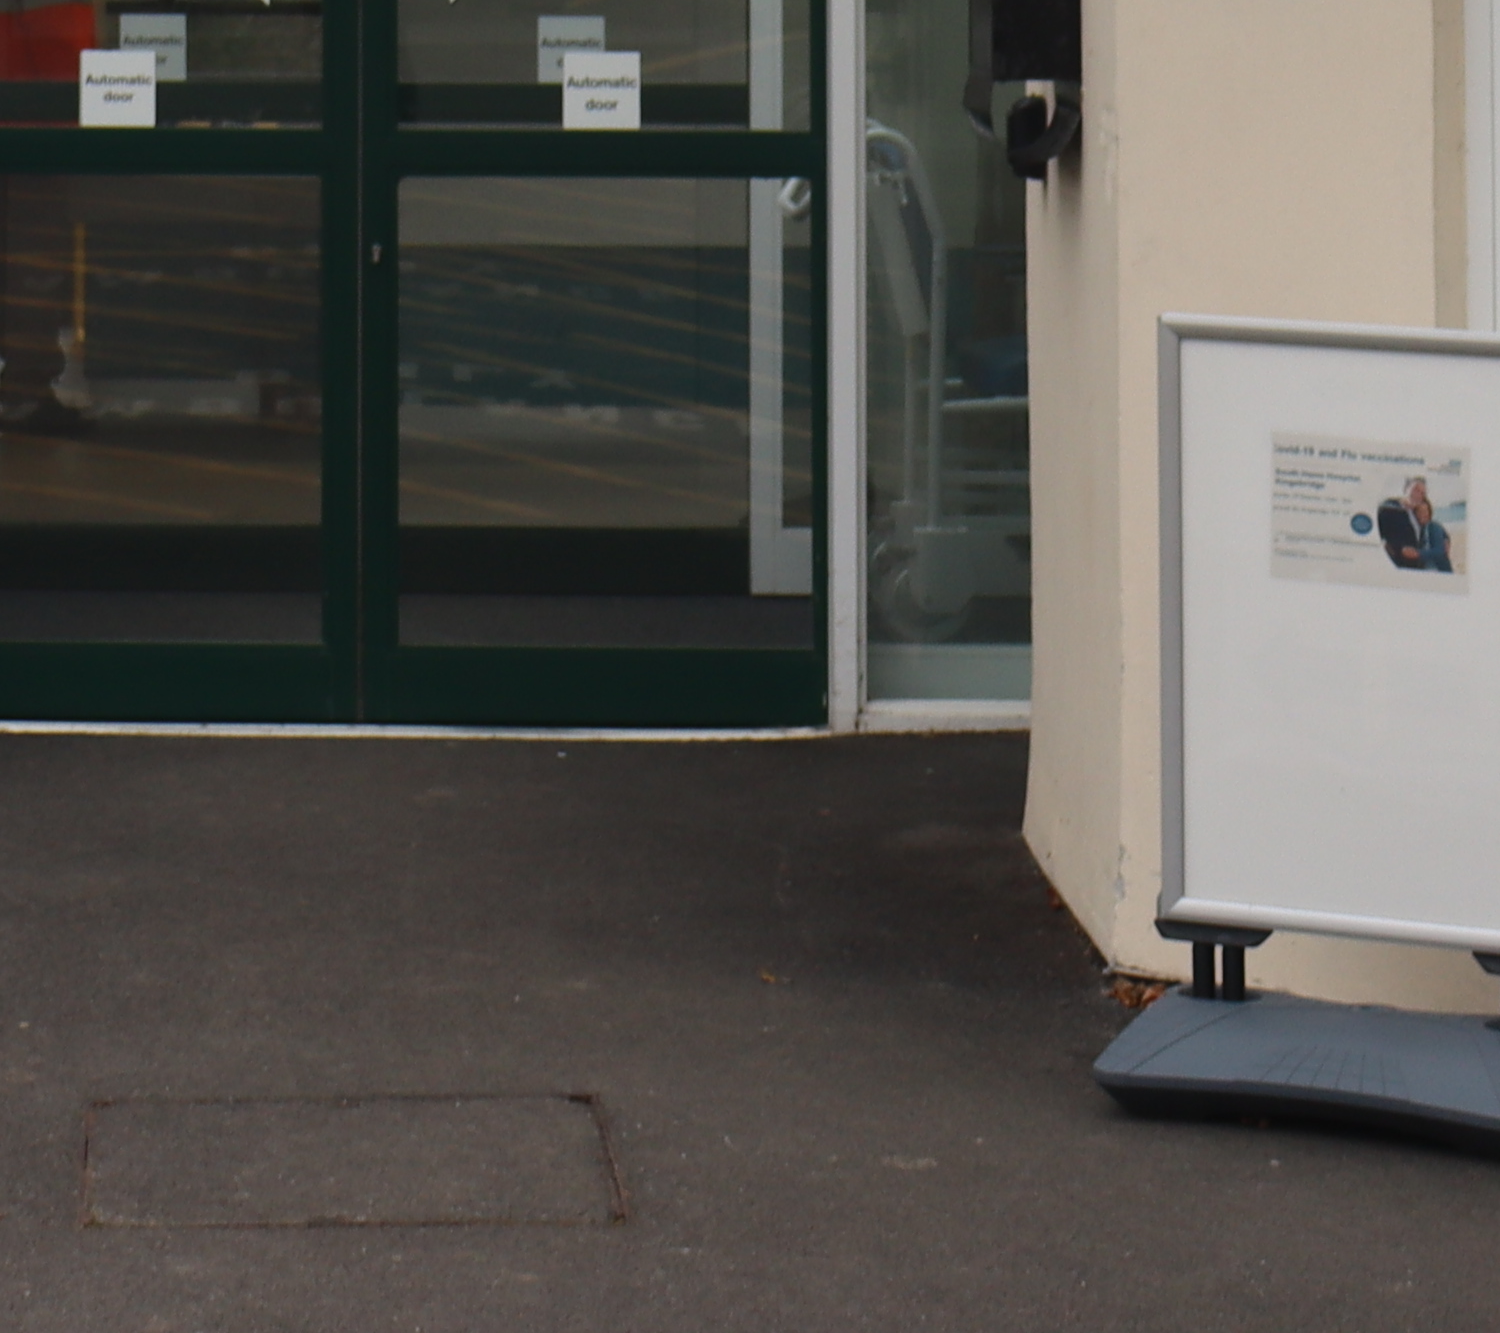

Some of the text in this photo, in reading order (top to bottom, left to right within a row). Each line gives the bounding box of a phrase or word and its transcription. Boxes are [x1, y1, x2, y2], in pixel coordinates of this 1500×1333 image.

[123, 35, 183, 47] Automatic
[540, 36, 602, 49] Automatic
[85, 74, 153, 87] Automatic
[566, 76, 637, 89] Automatic
[103, 90, 133, 103] door
[585, 97, 618, 111] door
